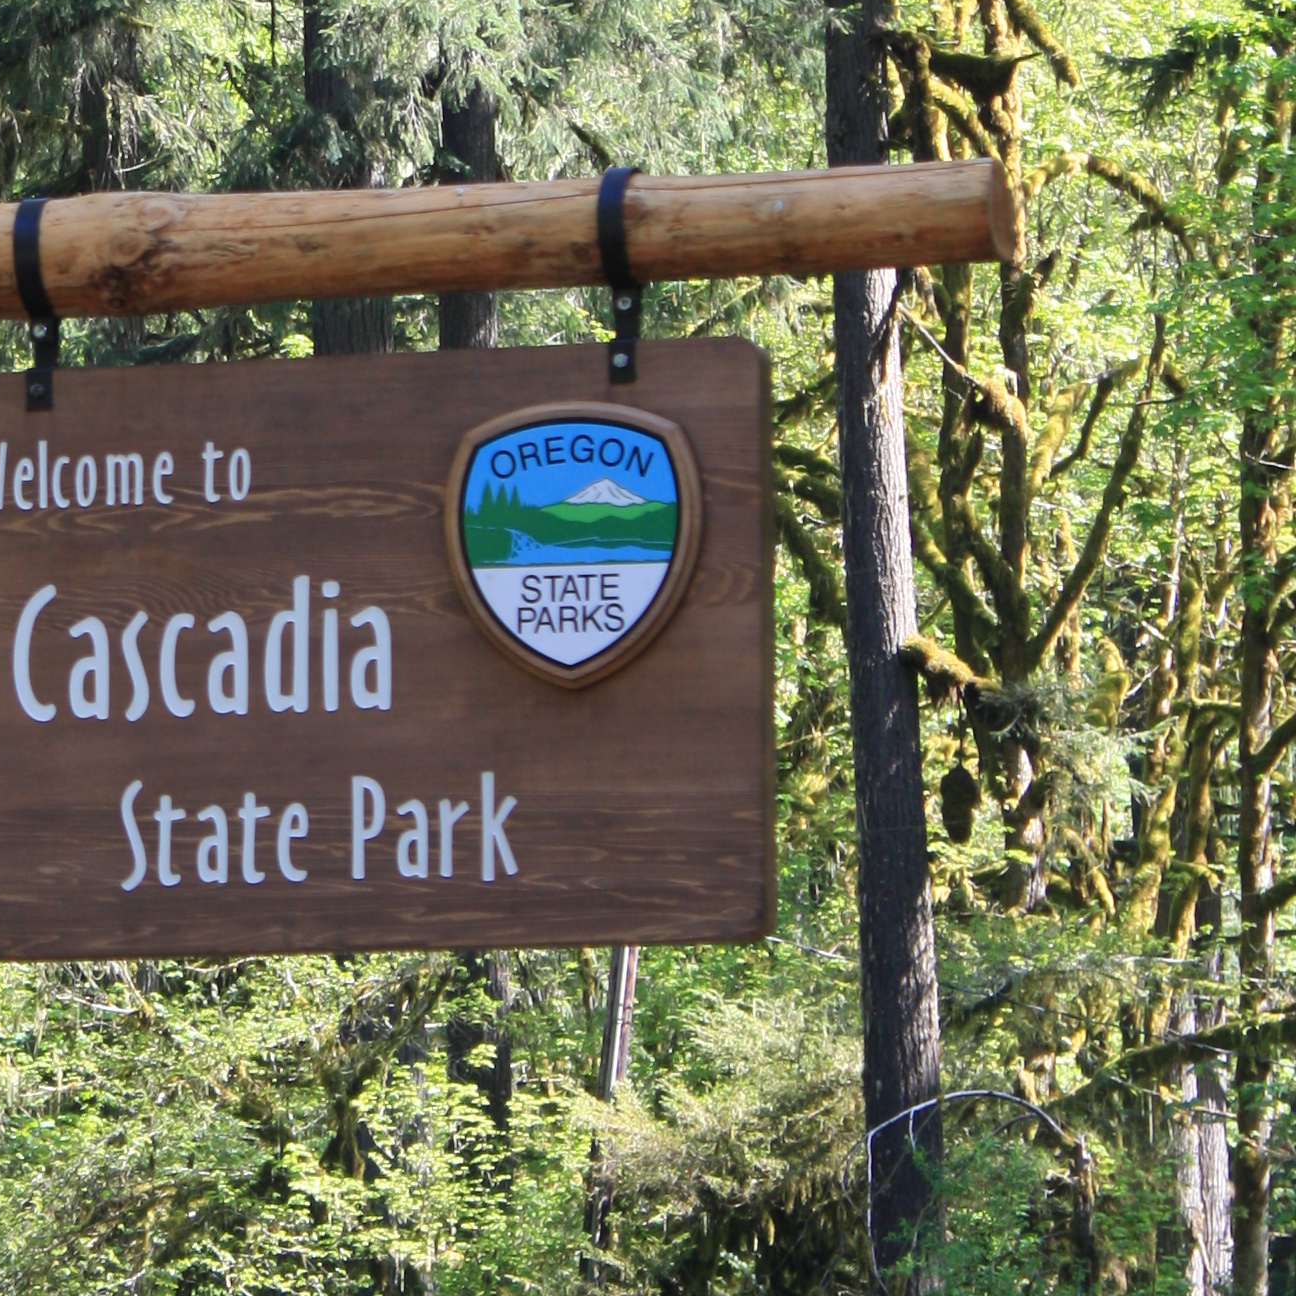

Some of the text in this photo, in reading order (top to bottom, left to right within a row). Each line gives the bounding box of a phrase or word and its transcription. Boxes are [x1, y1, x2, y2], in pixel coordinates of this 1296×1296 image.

[201, 441, 252, 503] to
[490, 434, 654, 479] OREGON
[521, 572, 621, 604] STATE
[517, 603, 625, 634] PARKS
[12, 574, 393, 722] Cascadia
[120, 771, 519, 892] State Park
